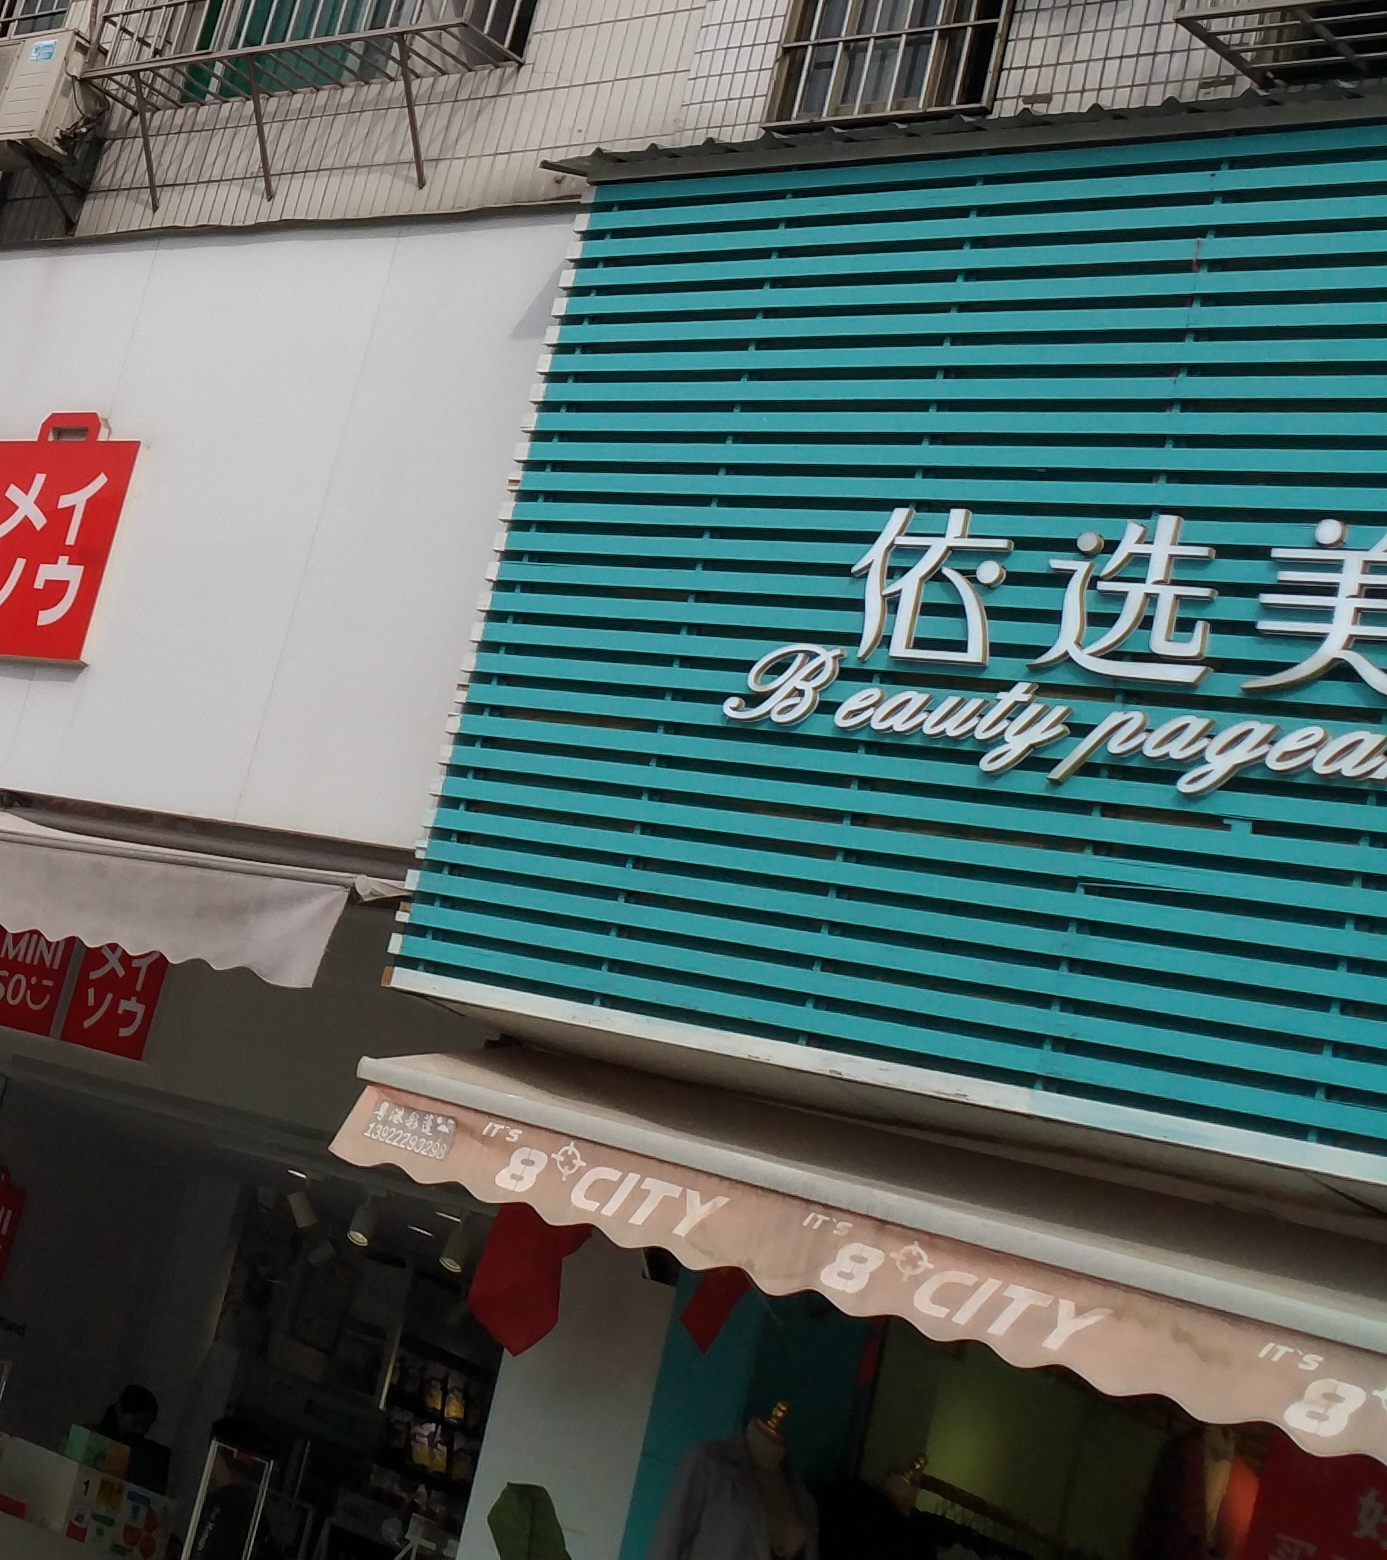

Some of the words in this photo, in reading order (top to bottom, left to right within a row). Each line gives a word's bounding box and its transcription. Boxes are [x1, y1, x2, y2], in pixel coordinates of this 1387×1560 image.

[722, 642, 1076, 776] Beauty
[0, 931, 66, 970] MINI
[88, 944, 161, 992] メイ
[82, 986, 147, 1038] ソウ
[494, 1146, 549, 1193] 8
[569, 1164, 731, 1238] CITY
[819, 1242, 886, 1294] 8
[912, 1269, 1114, 1352] CITY
[1282, 1377, 1368, 1437] 8
